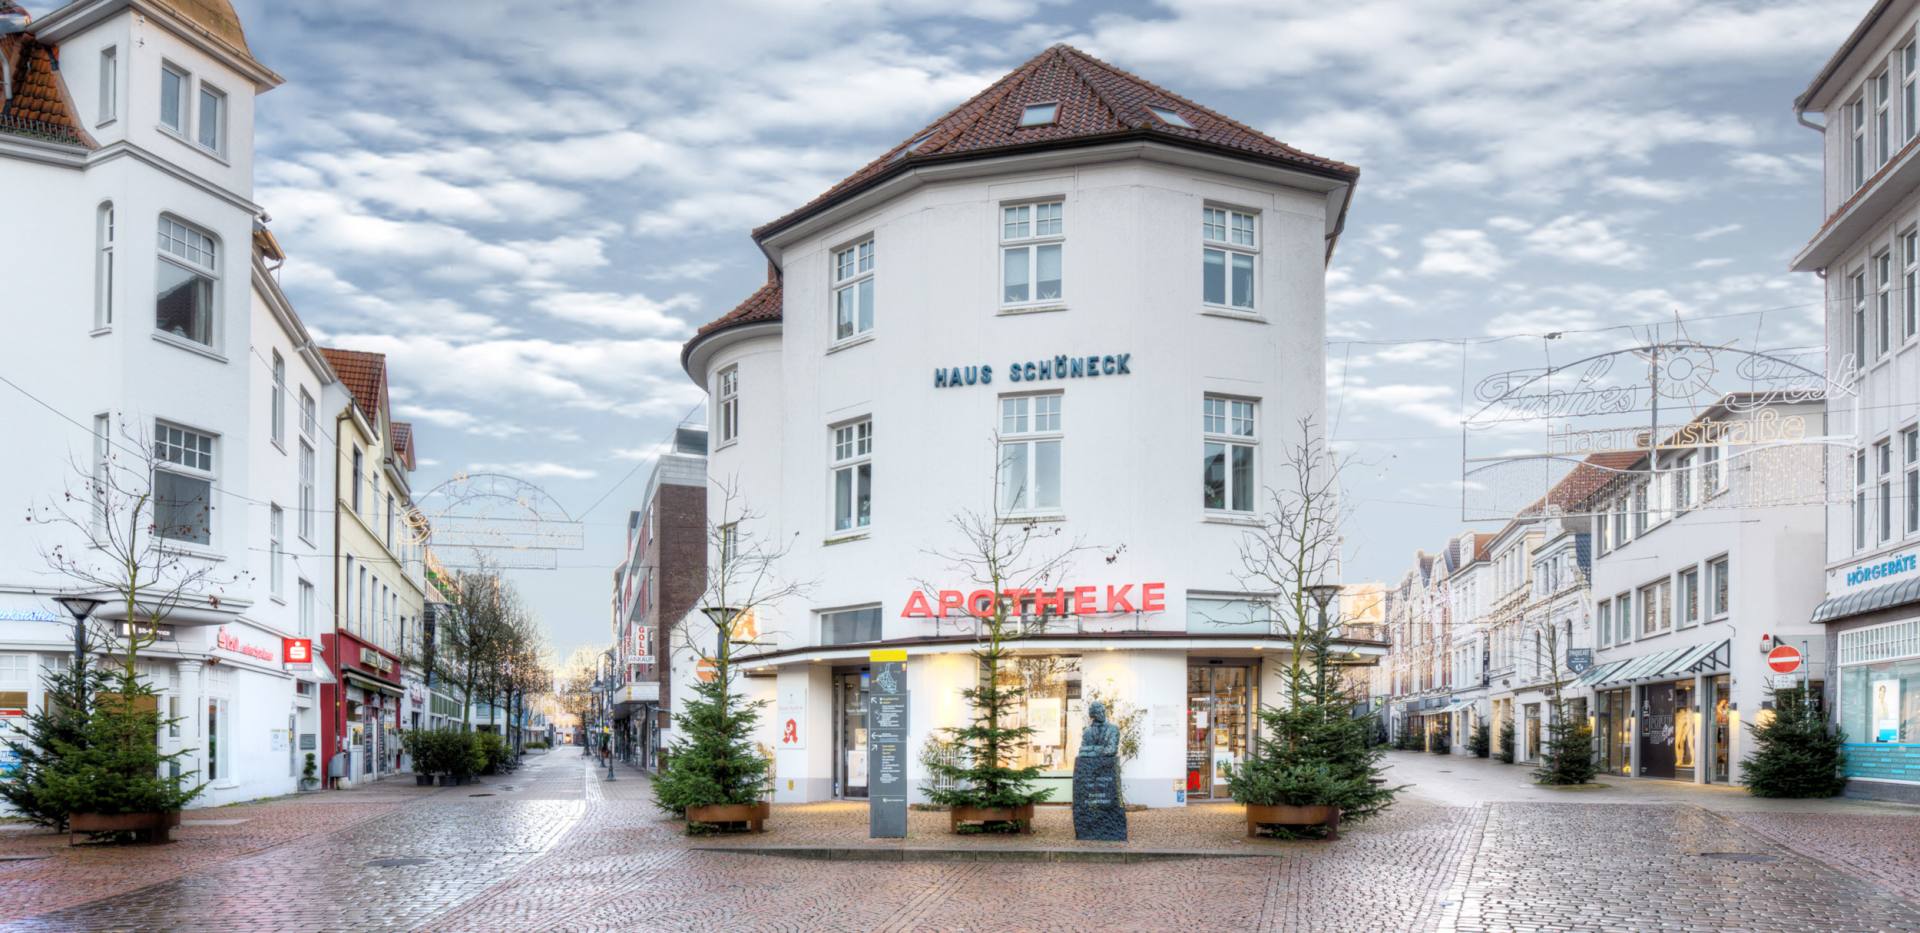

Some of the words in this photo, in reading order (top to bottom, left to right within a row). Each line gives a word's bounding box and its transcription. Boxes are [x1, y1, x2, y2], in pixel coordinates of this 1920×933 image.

[934, 365, 993, 388] HAUS
[1009, 353, 1131, 383] SCHÖNECK
[1467, 354, 1637, 430] Frohes
[1724, 345, 1858, 414] Fest
[1547, 408, 1807, 455] Haarenstraße
[1847, 553, 1917, 587] HÖRGERÄTE
[900, 582, 1166, 618] APOTHEKE
